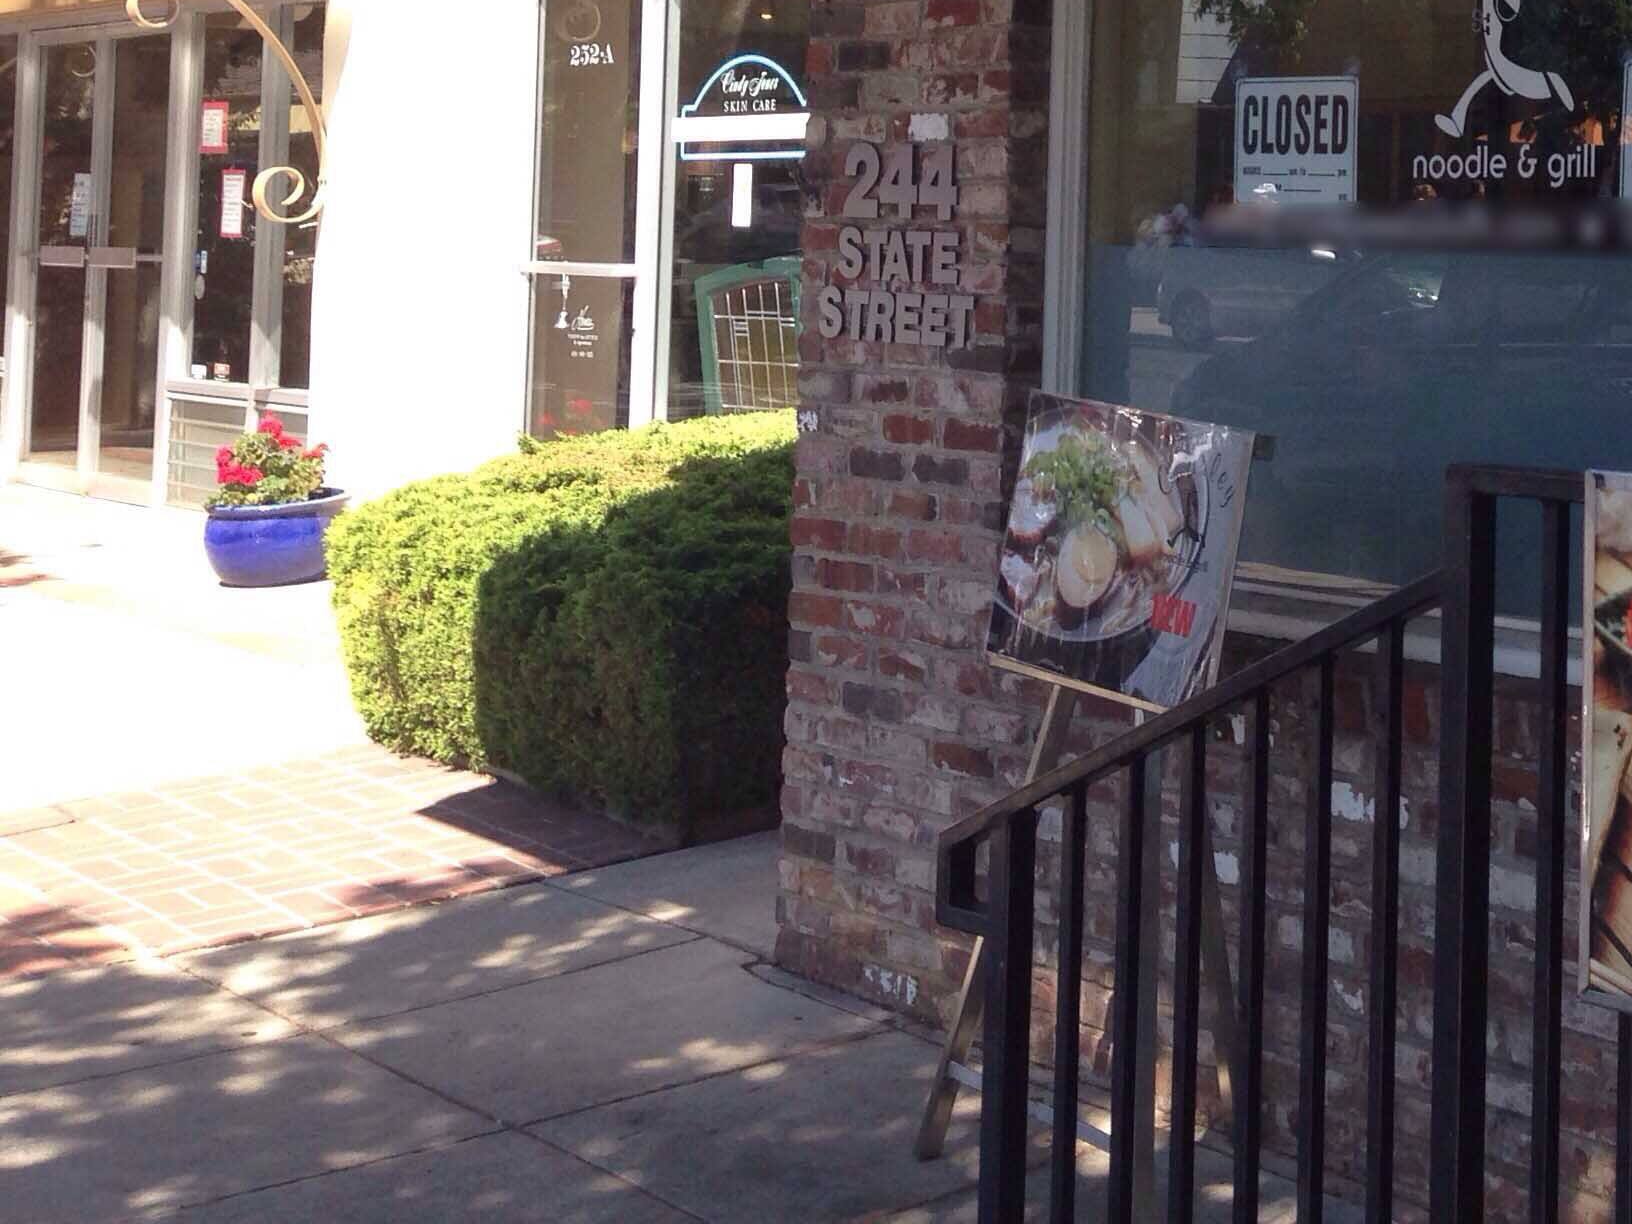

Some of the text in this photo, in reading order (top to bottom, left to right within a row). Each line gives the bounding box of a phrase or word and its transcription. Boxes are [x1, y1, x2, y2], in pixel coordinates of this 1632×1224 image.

[723, 98, 777, 113] SKIN CARE
[1243, 94, 1349, 155] CLOSED
[842, 141, 959, 221] 244
[1412, 143, 1597, 188] noodle & grill
[838, 225, 961, 284] STATE
[818, 284, 974, 349] STREET
